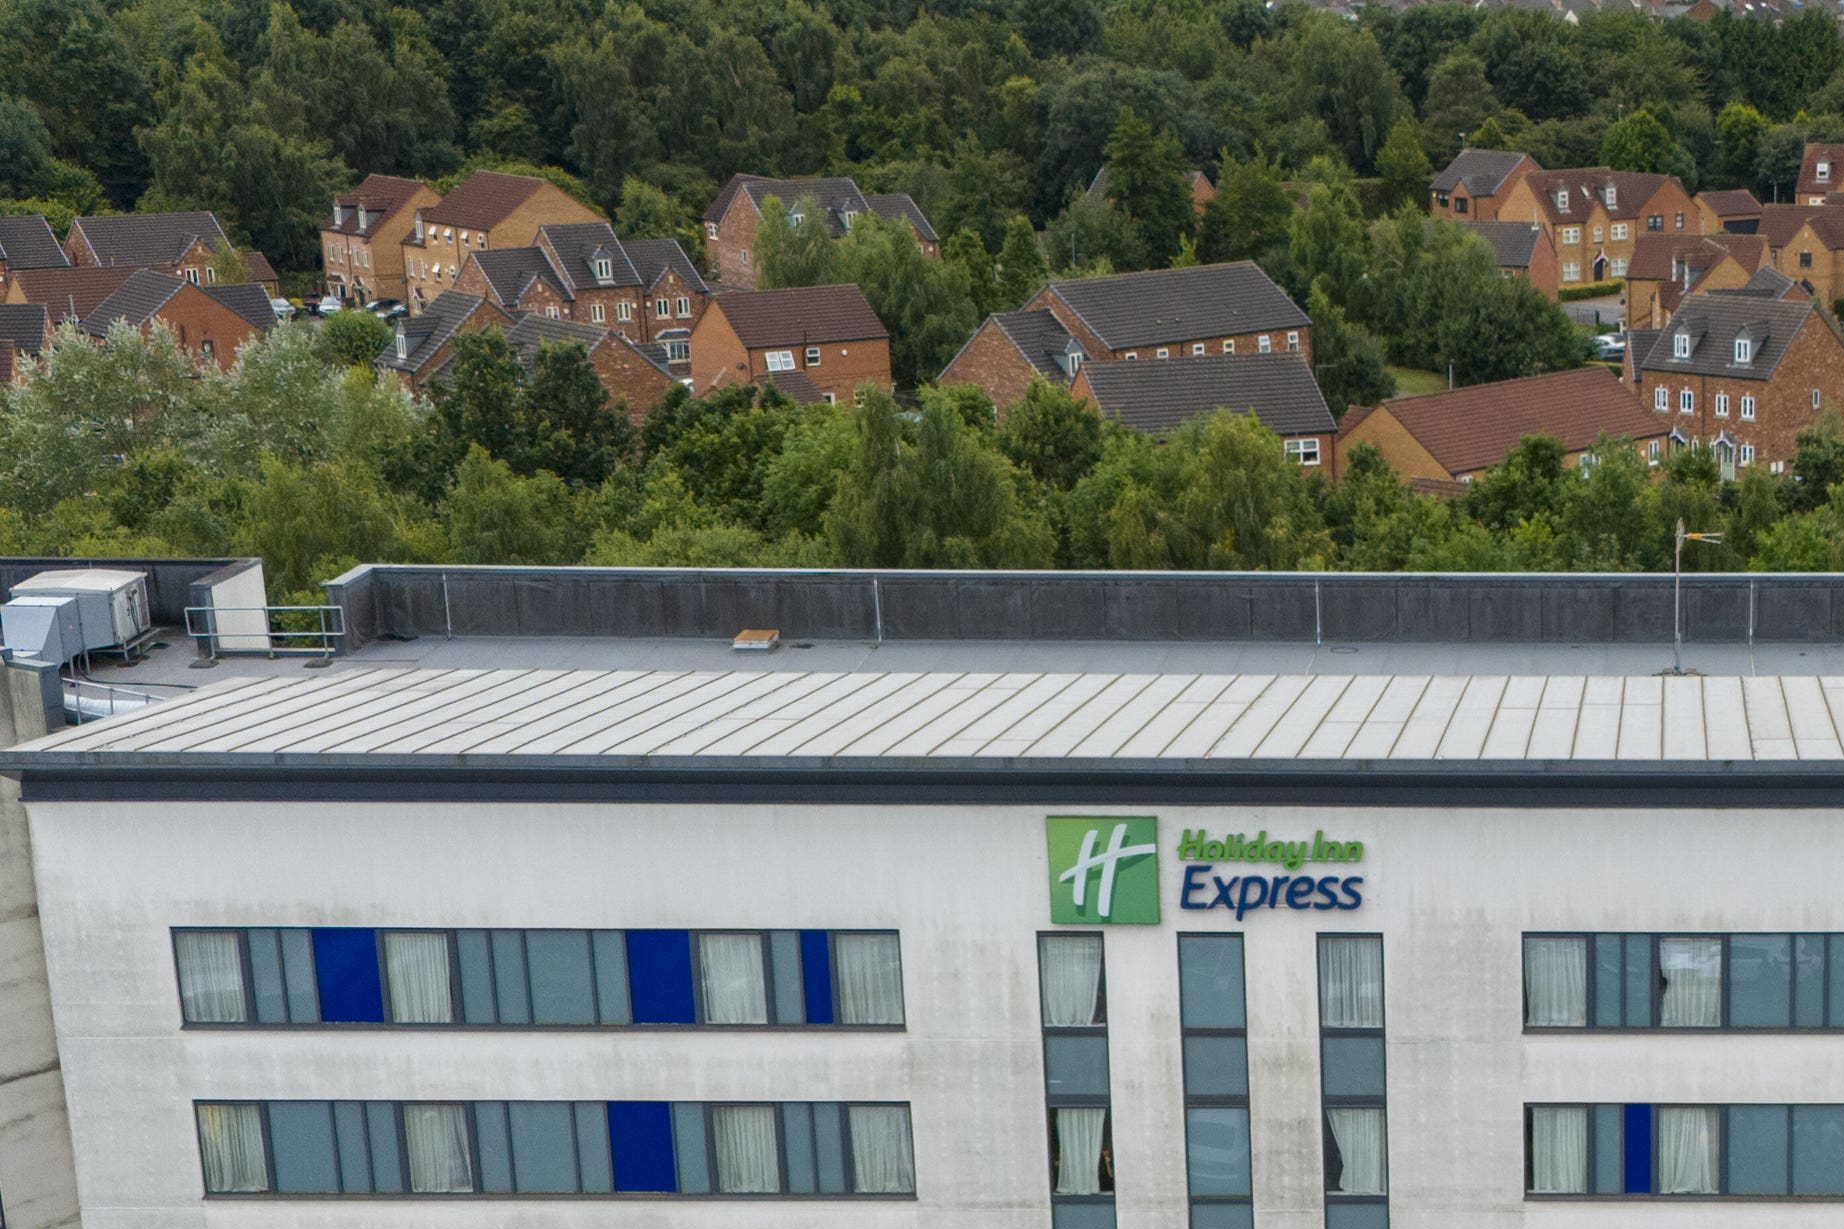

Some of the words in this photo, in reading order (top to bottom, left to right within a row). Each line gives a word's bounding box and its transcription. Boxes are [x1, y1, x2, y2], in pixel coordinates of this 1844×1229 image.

[1177, 829, 1307, 870] Holiday
[1311, 830, 1364, 862] Inn
[1180, 865, 1364, 922] Express
